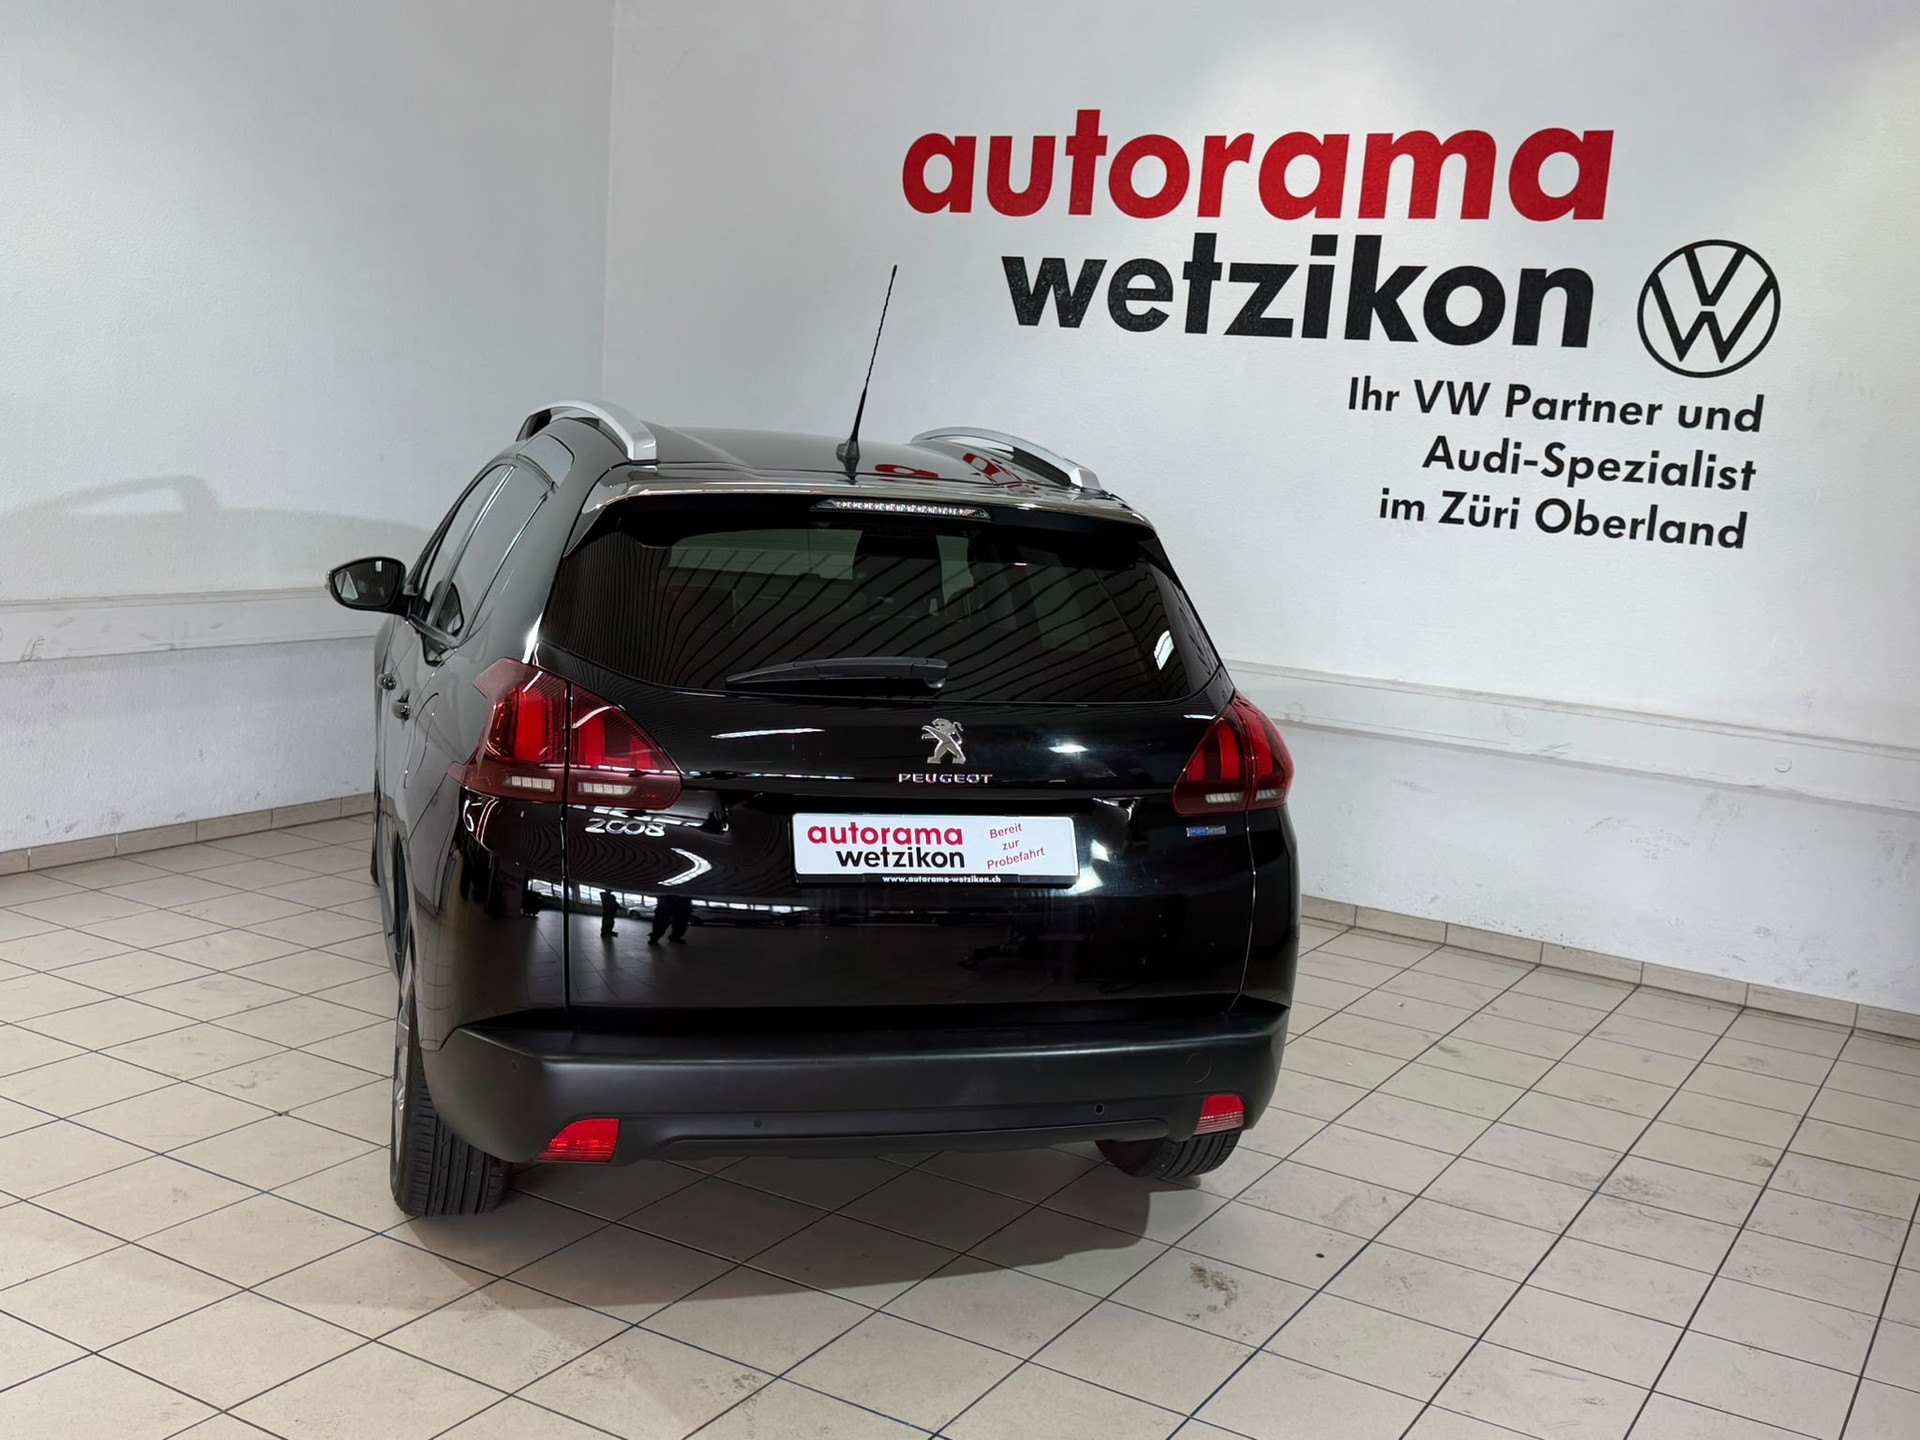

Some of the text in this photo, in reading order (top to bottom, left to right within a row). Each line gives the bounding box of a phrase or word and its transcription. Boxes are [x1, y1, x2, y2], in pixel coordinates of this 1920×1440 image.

[902, 110, 1615, 221] autorama
[1001, 233, 1595, 348] wetzikon
[1348, 375, 1765, 433] Ihr VW Partner und
[1422, 435, 1757, 491] Audi-Spezialist
[1379, 488, 1748, 549] im Züri Oberland
[898, 773, 993, 784] PEUGEOT
[585, 818, 666, 837] 2008
[807, 822, 963, 846] autorama
[989, 822, 1023, 839] Bereit
[1002, 839, 1020, 851] zur
[836, 847, 965, 868] wetzikon
[986, 847, 1045, 870] Probefahrt
[882, 875, 1002, 883] www.autorama-wetzikon.ch
